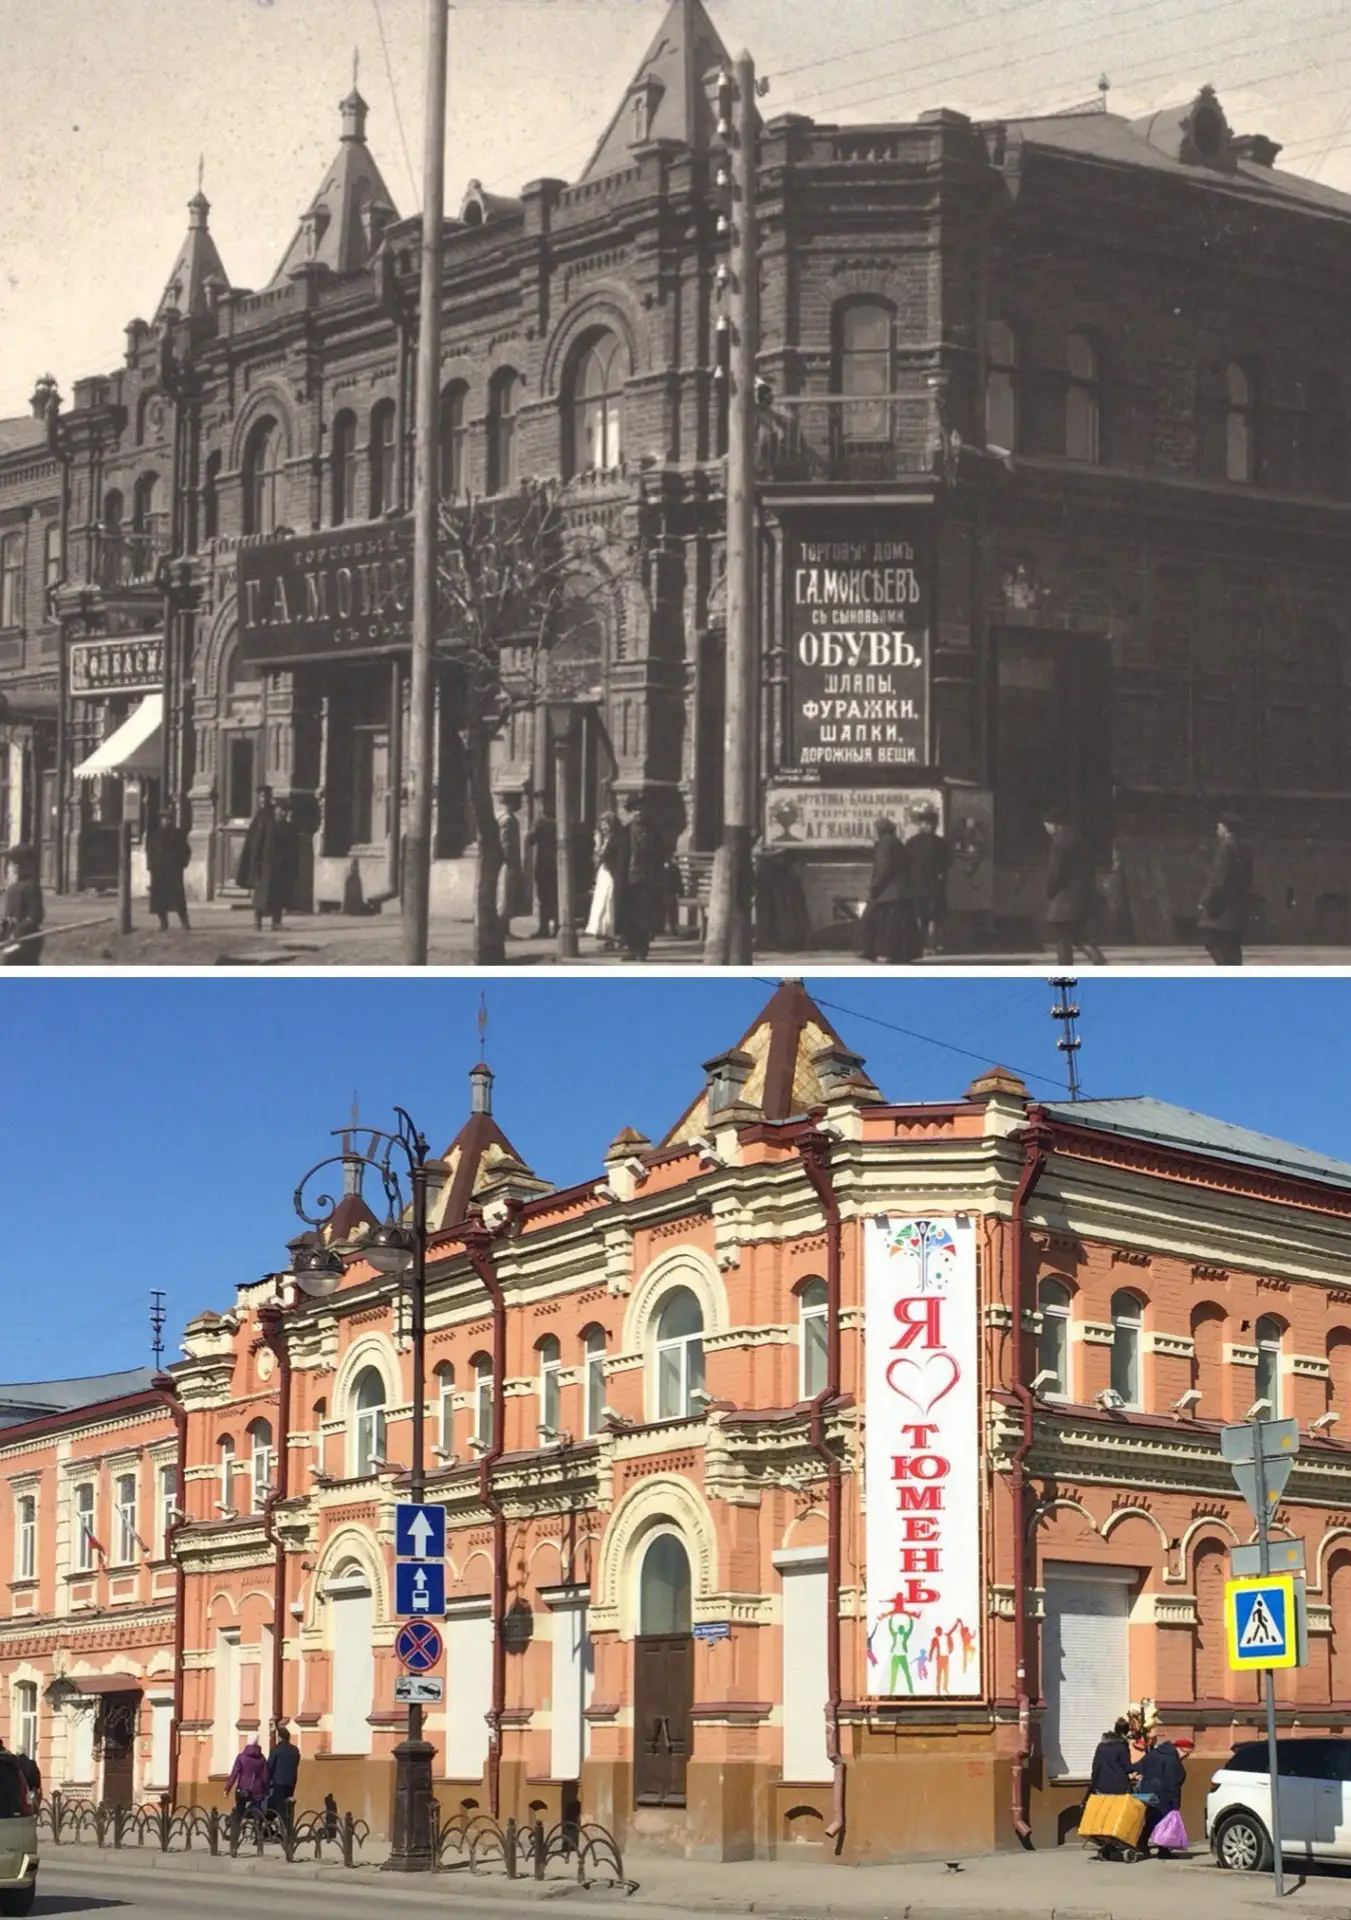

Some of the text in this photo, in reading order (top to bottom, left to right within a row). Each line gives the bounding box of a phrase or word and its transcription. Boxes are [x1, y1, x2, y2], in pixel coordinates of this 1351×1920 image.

[799, 631, 922, 668] ОБУВЬ,
[889, 1297, 952, 1605] Я ТЮМЕНЬ
